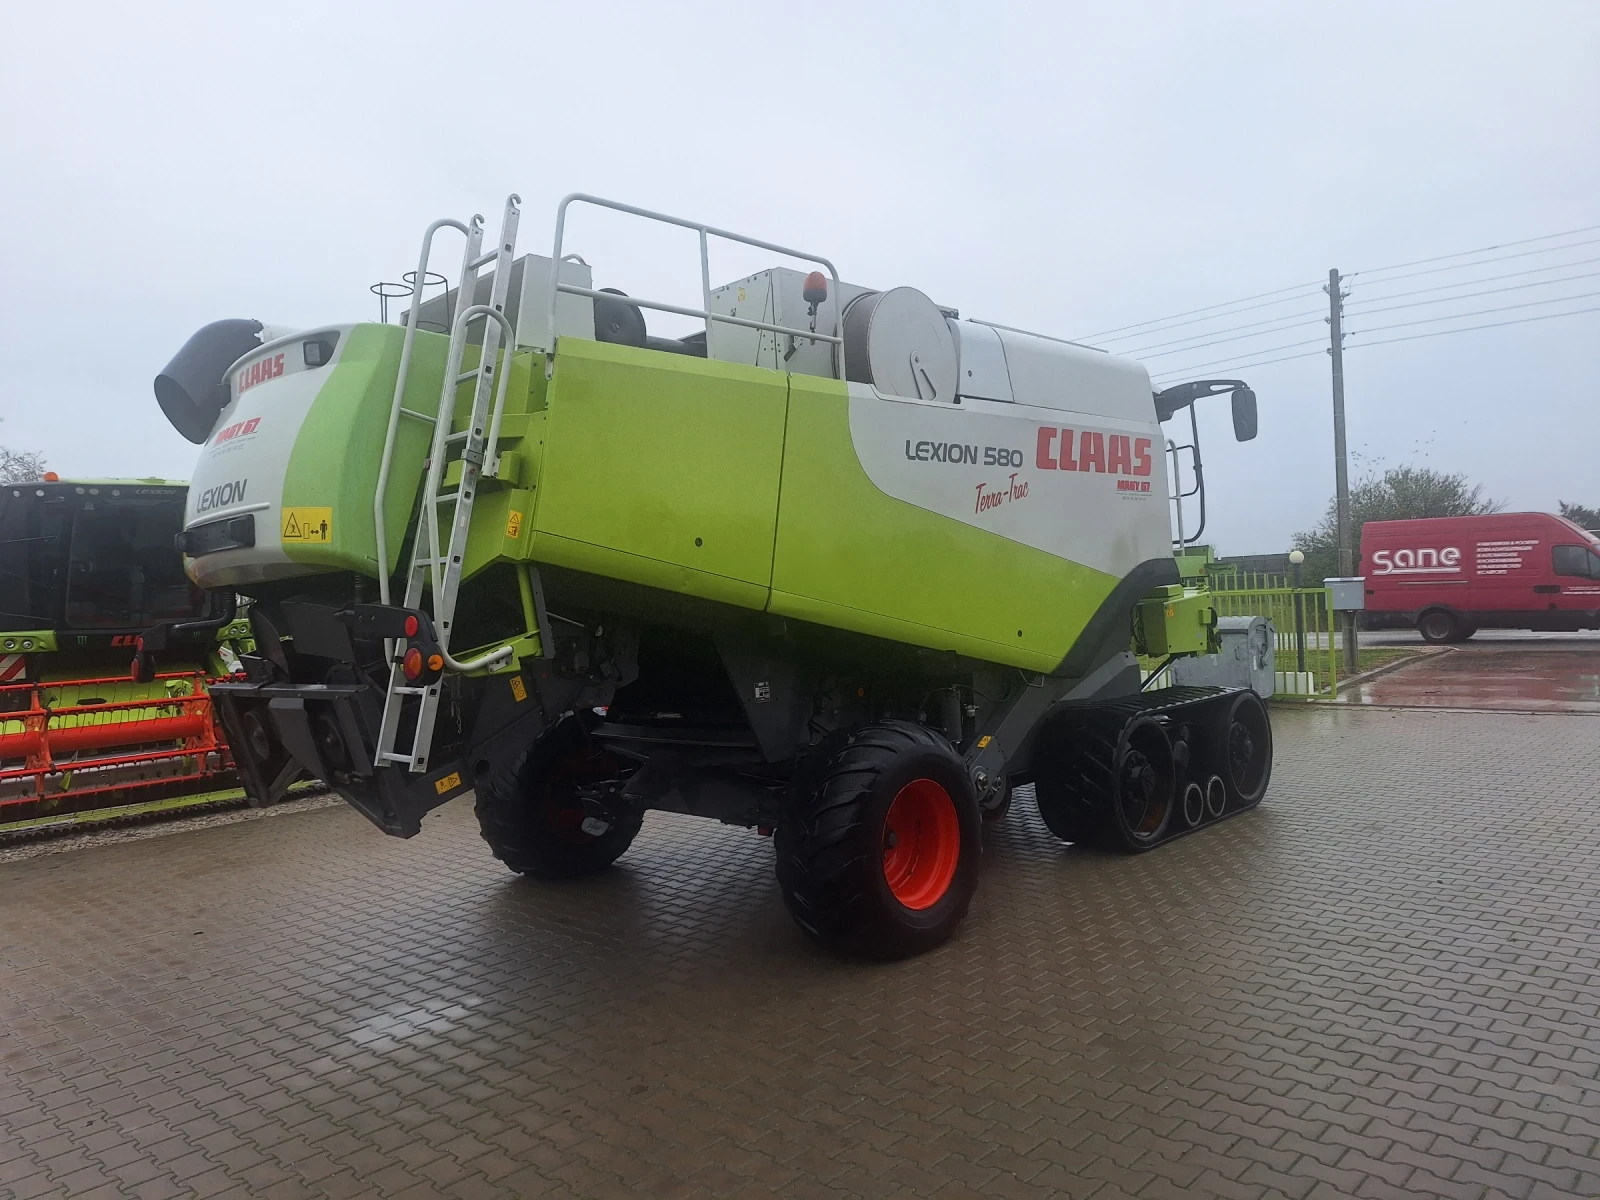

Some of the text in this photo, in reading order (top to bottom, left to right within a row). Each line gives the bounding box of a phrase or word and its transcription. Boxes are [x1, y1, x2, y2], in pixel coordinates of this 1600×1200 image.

[238, 353, 285, 395] CLAAS
[905, 440, 1024, 468] LEXION 580
[1036, 426, 1152, 477] CLAAS
[196, 478, 248, 514] LEXION
[975, 472, 1030, 514] Terra-Trac
[1372, 547, 1462, 574] sane
